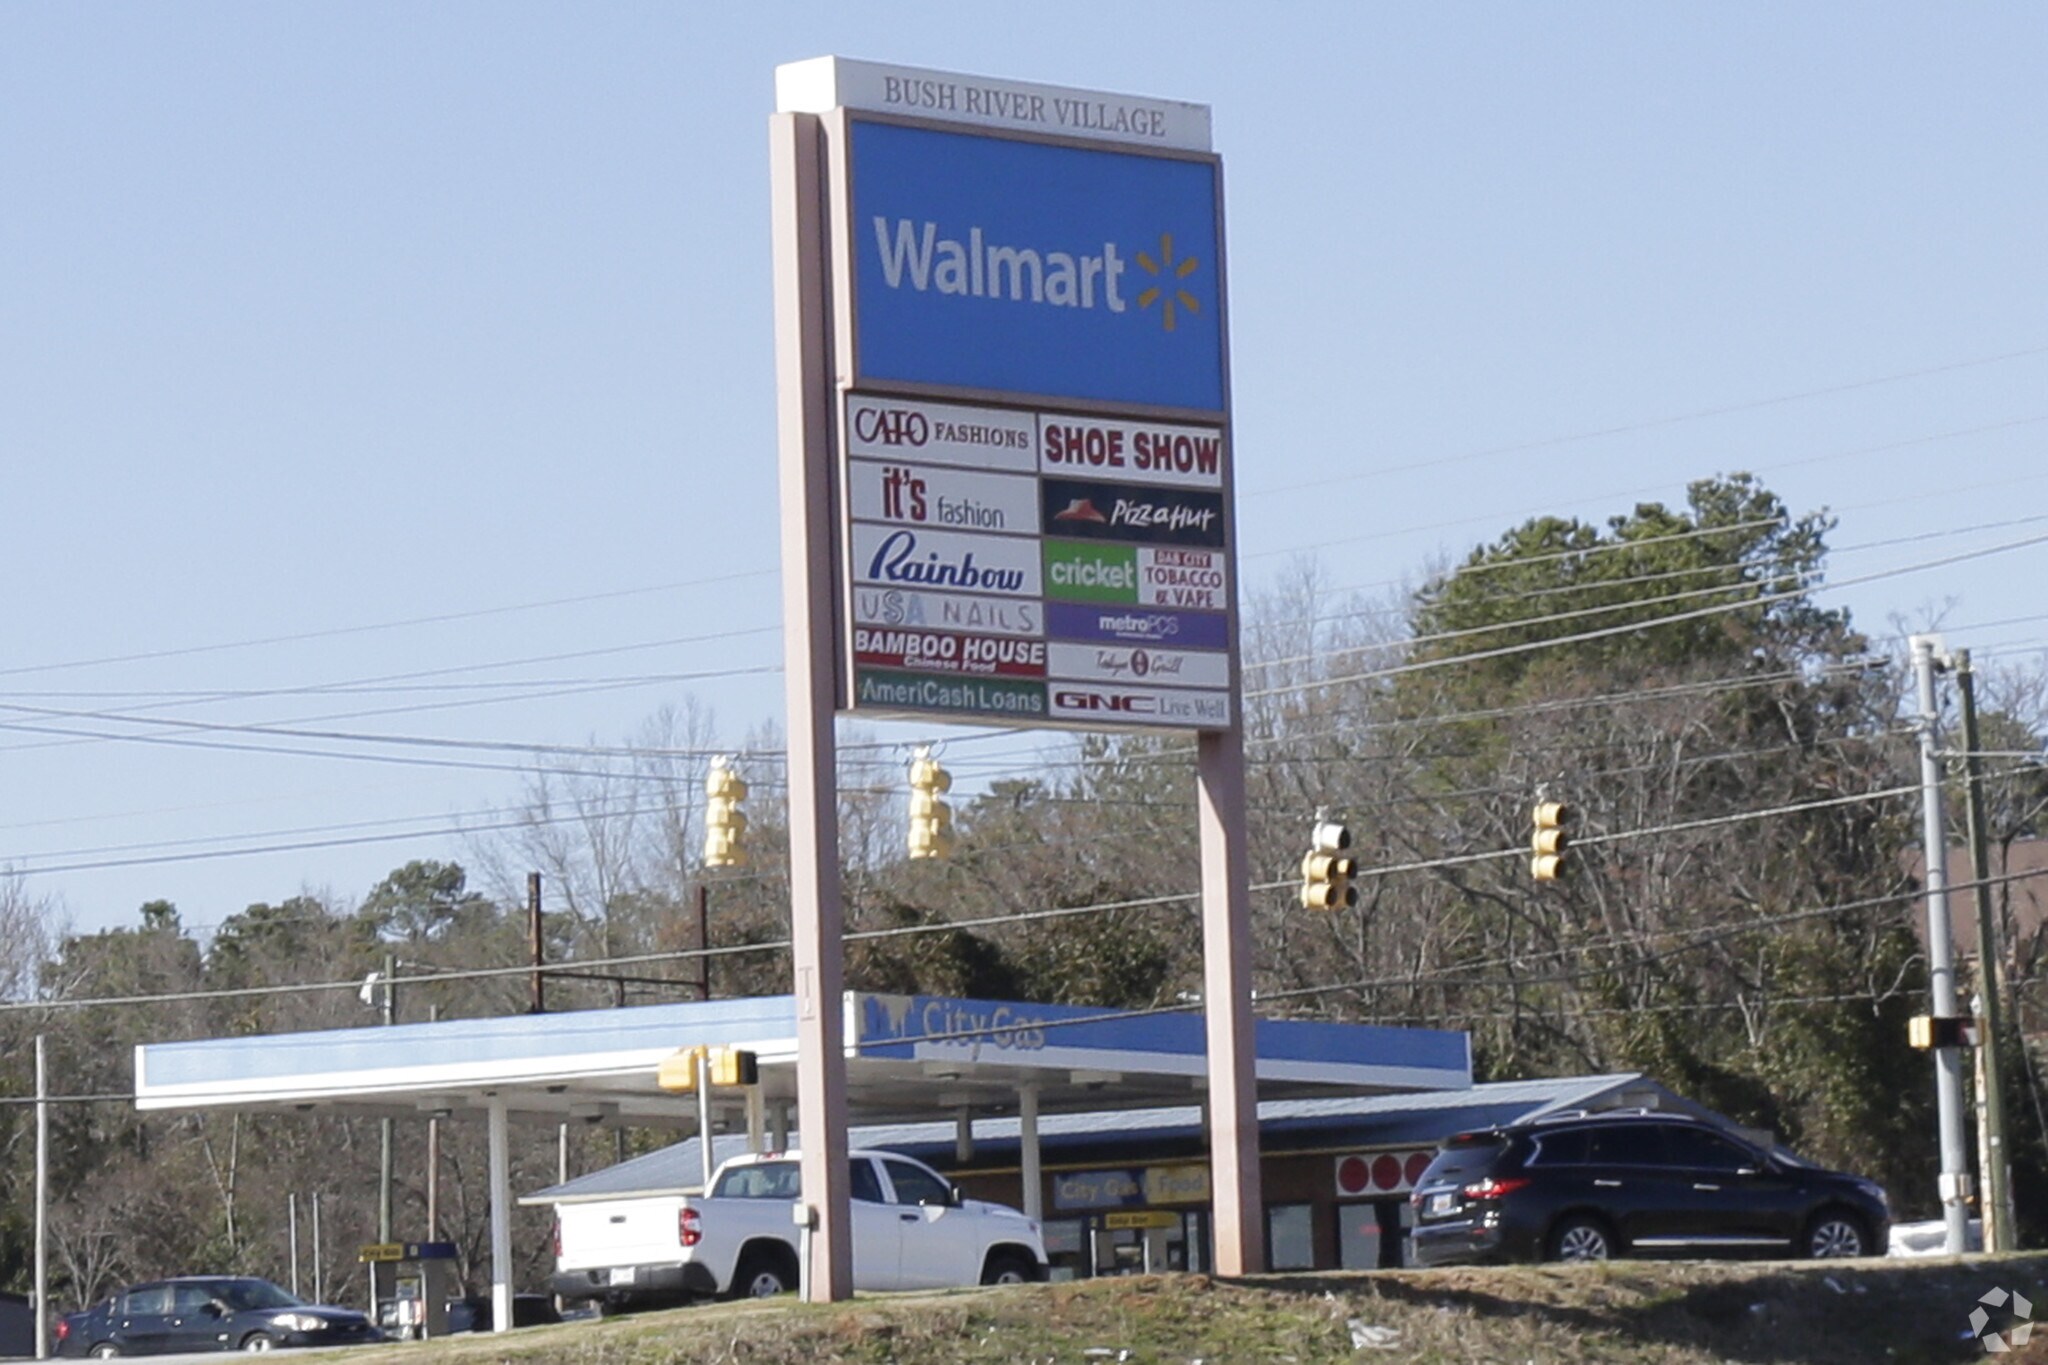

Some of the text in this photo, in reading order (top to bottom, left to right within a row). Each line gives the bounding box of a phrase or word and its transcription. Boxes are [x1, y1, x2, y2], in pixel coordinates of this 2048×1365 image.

[884, 76, 1167, 137] BUSH RIVER VILLAGE
[873, 215, 1126, 313] Walmart
[855, 407, 1029, 449] CATO FASHIONS
[1045, 424, 1220, 475] SHOE SHOW
[883, 466, 1005, 528] it's fashion
[868, 530, 1025, 591] Rainbow
[1051, 556, 1136, 589] cricket
[1145, 567, 1222, 589] TOBACCO
[861, 589, 1035, 632] USA NAILS
[1173, 588, 1214, 608] VAPE
[855, 630, 1045, 665] BAMBOO HOUSE
[979, 685, 1042, 712] Loans
[1055, 691, 1156, 714] GNC
[922, 1001, 1046, 1062] City Gas
